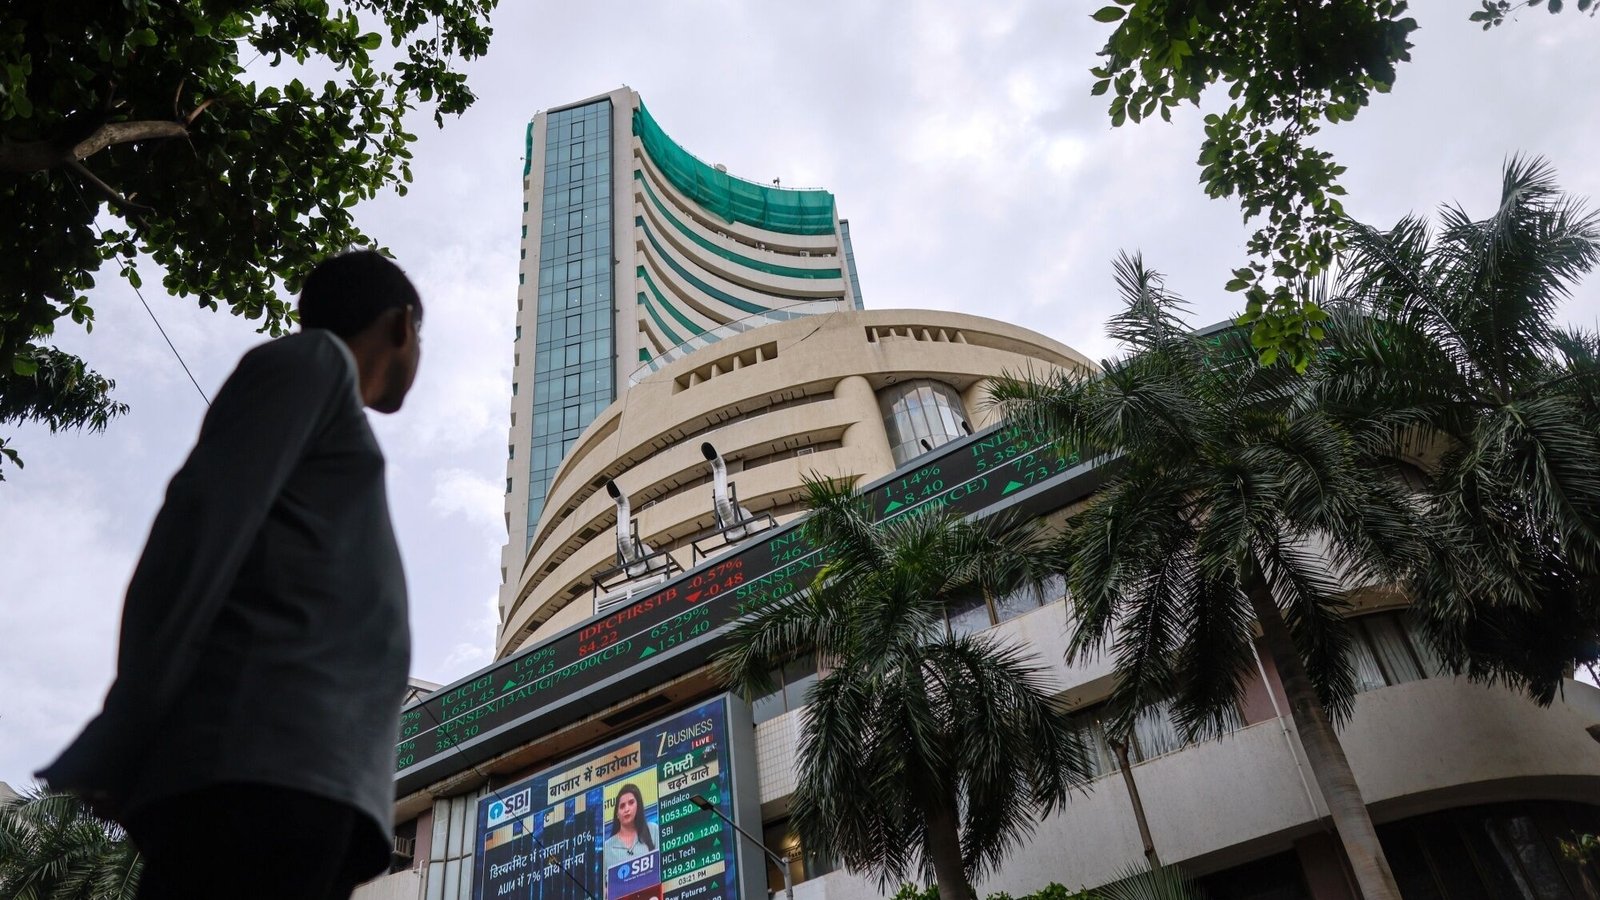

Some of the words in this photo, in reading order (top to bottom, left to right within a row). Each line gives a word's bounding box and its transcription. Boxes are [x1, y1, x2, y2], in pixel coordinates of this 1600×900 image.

[885, 464, 940, 497] 1.14%
[1024, 452, 1079, 484] 73.25
[905, 480, 944, 504] 8.40
[578, 588, 678, 642] IDFCFIRSTB
[687, 559, 743, 589] -0.57%
[578, 631, 617, 657] 84.22
[704, 572, 744, 597] -0.48
[651, 605, 709, 639] 65.29%
[659, 620, 710, 650] 151.40
[442, 674, 493, 706] ICICIGI
[514, 646, 556, 672] 1.69%
[518, 660, 555, 686] 27.45
[435, 725, 479, 752] 383.30
[667, 718, 713, 748] BUSINESS
[695, 735, 710, 747] LIVE
[550, 775, 581, 796] बाजार
[584, 766, 593, 782] में
[595, 751, 638, 777] कारोबार
[663, 753, 694, 778] निफ्टी
[668, 773, 688, 790] चढ़ने
[691, 765, 709, 781] वाले
[505, 789, 529, 814] SBI
[660, 793, 690, 809] Hindalco
[661, 804, 693, 823] 1053.50
[661, 826, 674, 837] SBI
[662, 832, 694, 852] 1097.00
[700, 824, 719, 837] 12.00
[631, 854, 654, 875] SBI
[662, 853, 676, 865] HCL
[679, 846, 695, 859] Tech
[663, 860, 696, 879] 1349.30
[701, 852, 720, 866] 14.30
[527, 870, 541, 885] 7%
[678, 874, 695, 885] 03:21
[698, 870, 707, 879] PM
[681, 886, 707, 899] Futures
